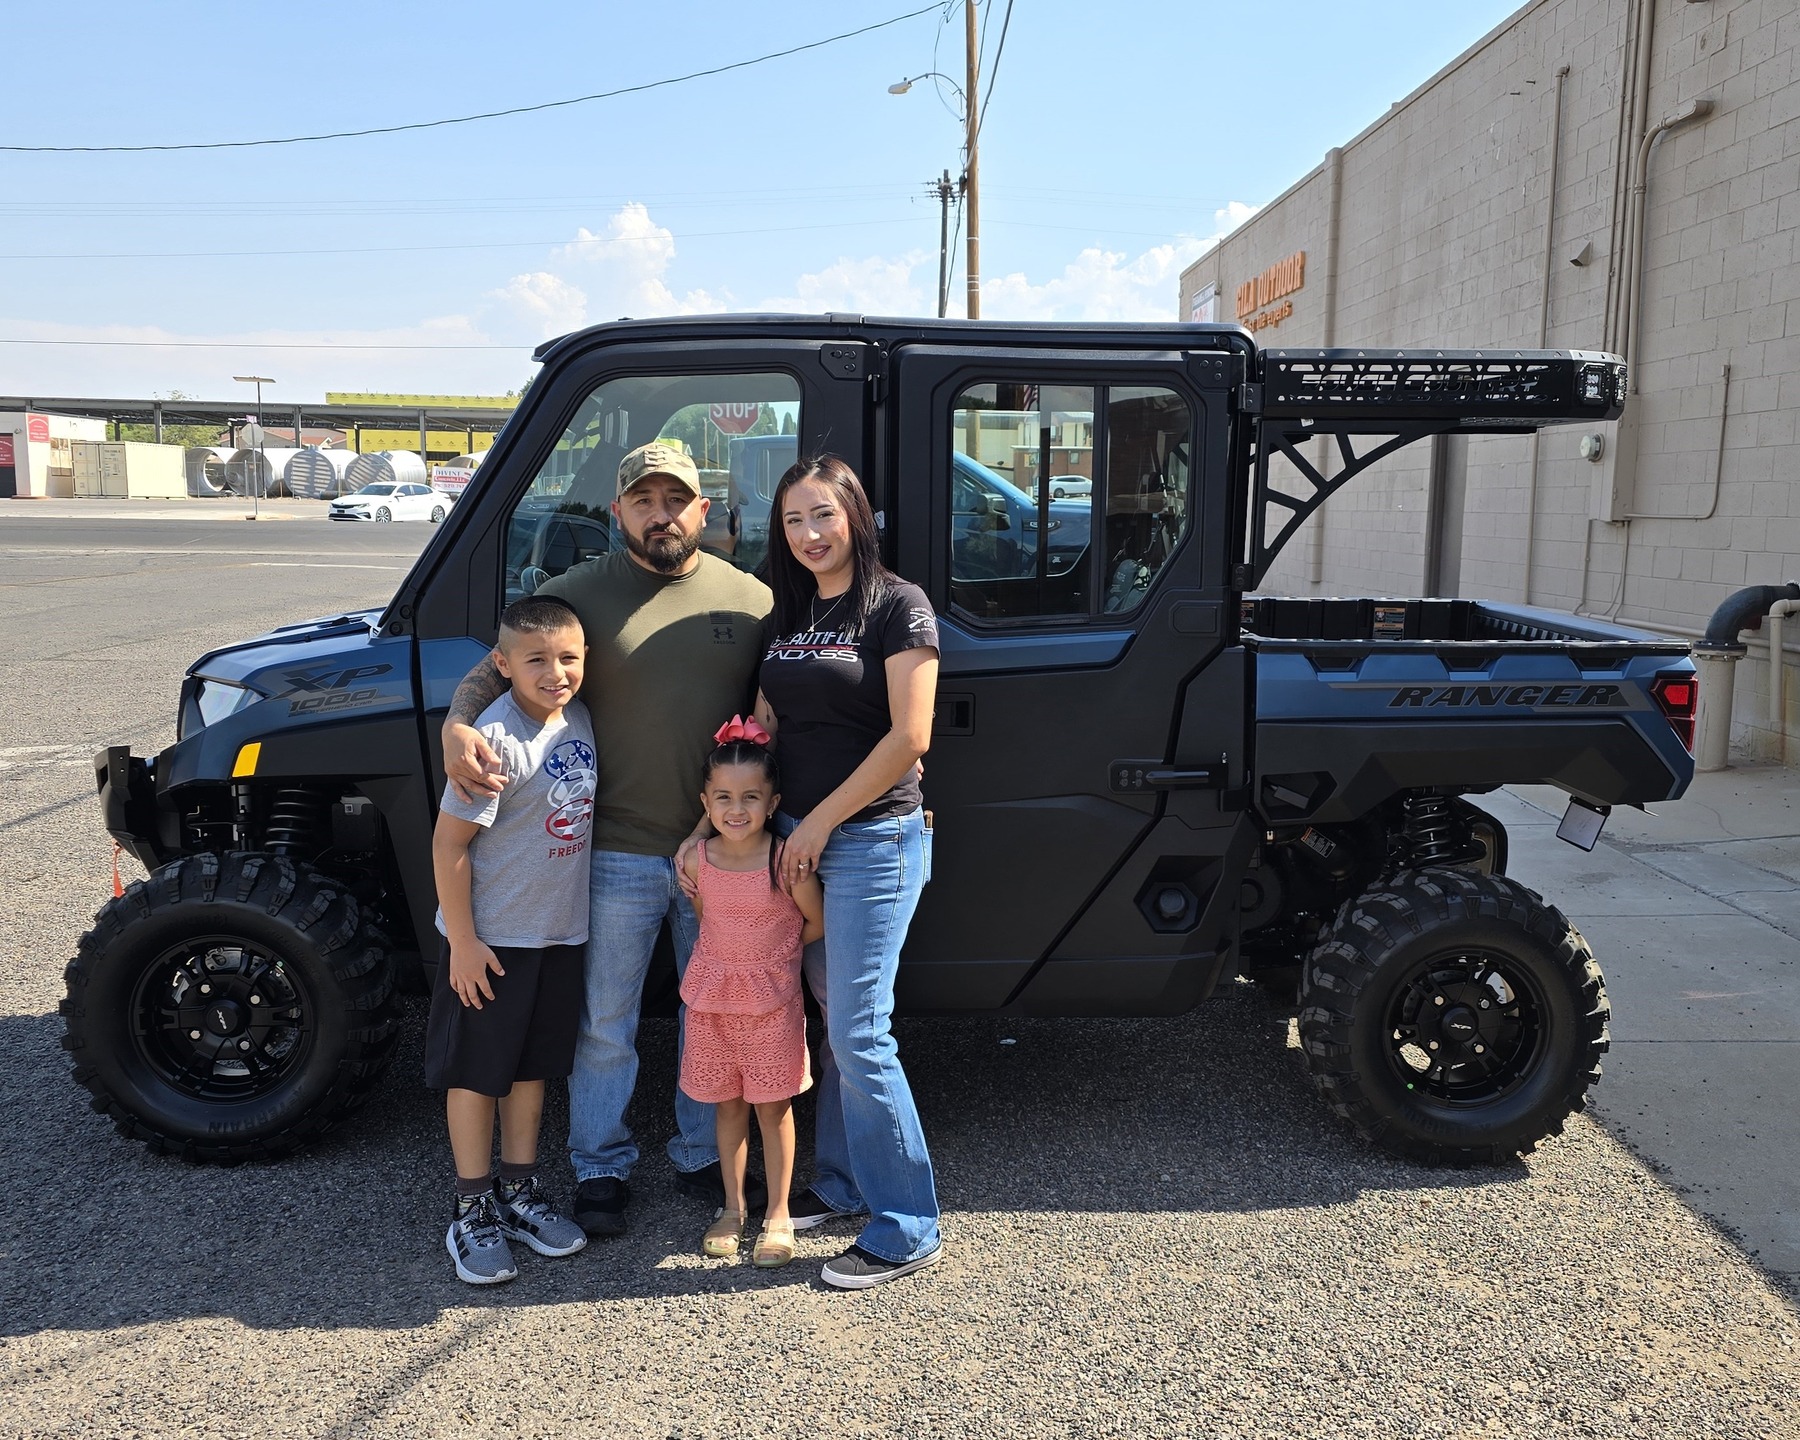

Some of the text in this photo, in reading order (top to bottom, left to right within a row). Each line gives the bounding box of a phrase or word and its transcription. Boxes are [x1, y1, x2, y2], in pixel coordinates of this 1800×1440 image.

[1236, 250, 1305, 319] GILA OUTDOOR
[1301, 374, 1541, 392] ROUGH COUNTRY
[713, 403, 755, 418] STOP
[271, 663, 394, 701] XP
[289, 688, 378, 712] 1000
[1387, 684, 1621, 708] RANGER
